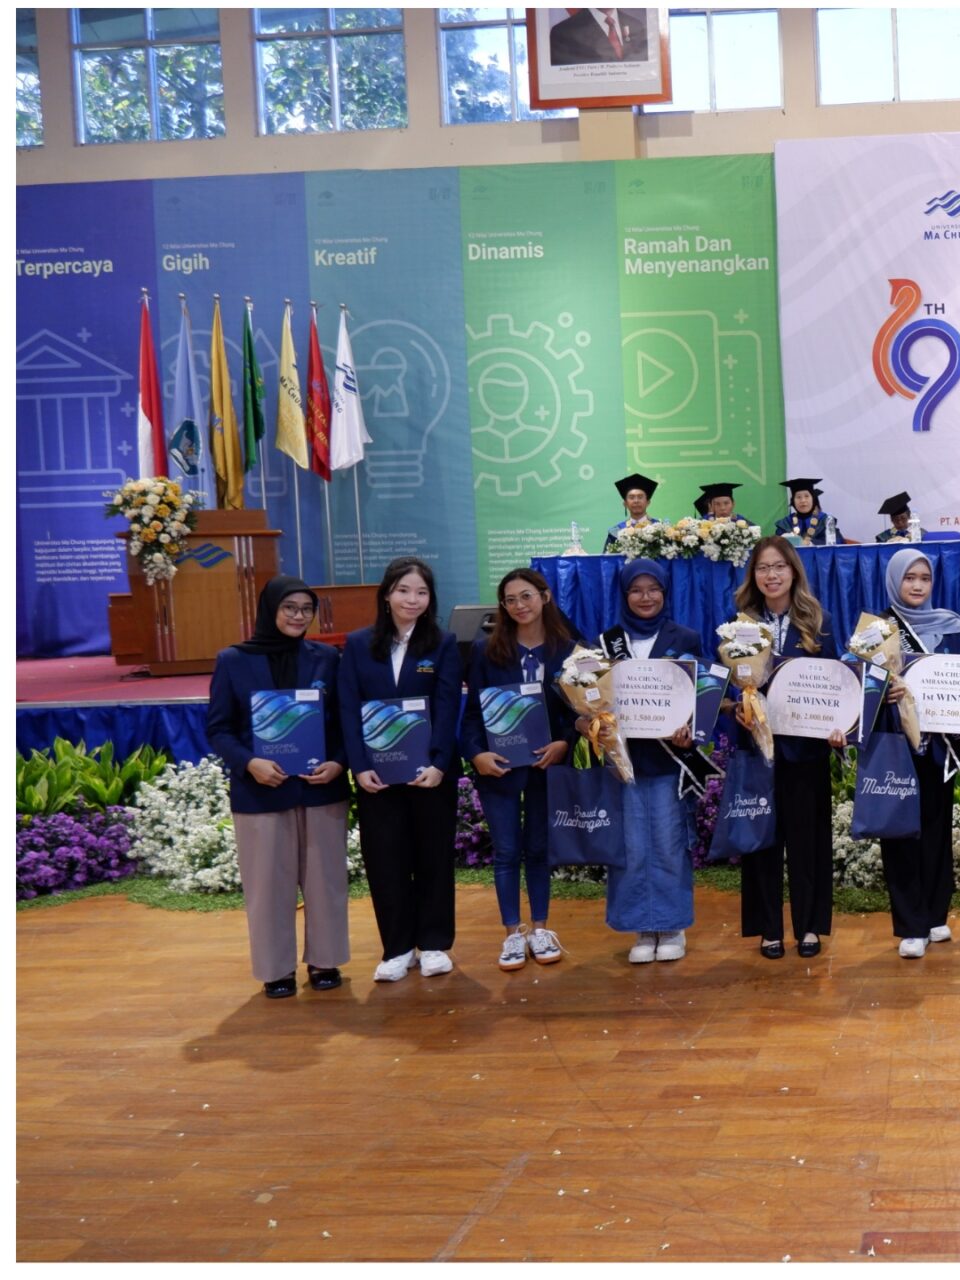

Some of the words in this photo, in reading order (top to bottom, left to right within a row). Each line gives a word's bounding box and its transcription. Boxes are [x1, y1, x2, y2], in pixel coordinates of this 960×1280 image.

[468, 240, 544, 261] Dinamis
[624, 236, 690, 255] Ramah
[696, 235, 732, 253] Dan
[162, 251, 210, 275] Gigih
[314, 247, 377, 268] Kreatif
[624, 254, 769, 278] Menyenangkan
[924, 304, 946, 316] TH
[632, 698, 671, 707] WINNER
[786, 695, 800, 704] 2nd
[802, 696, 840, 708] WINNER
